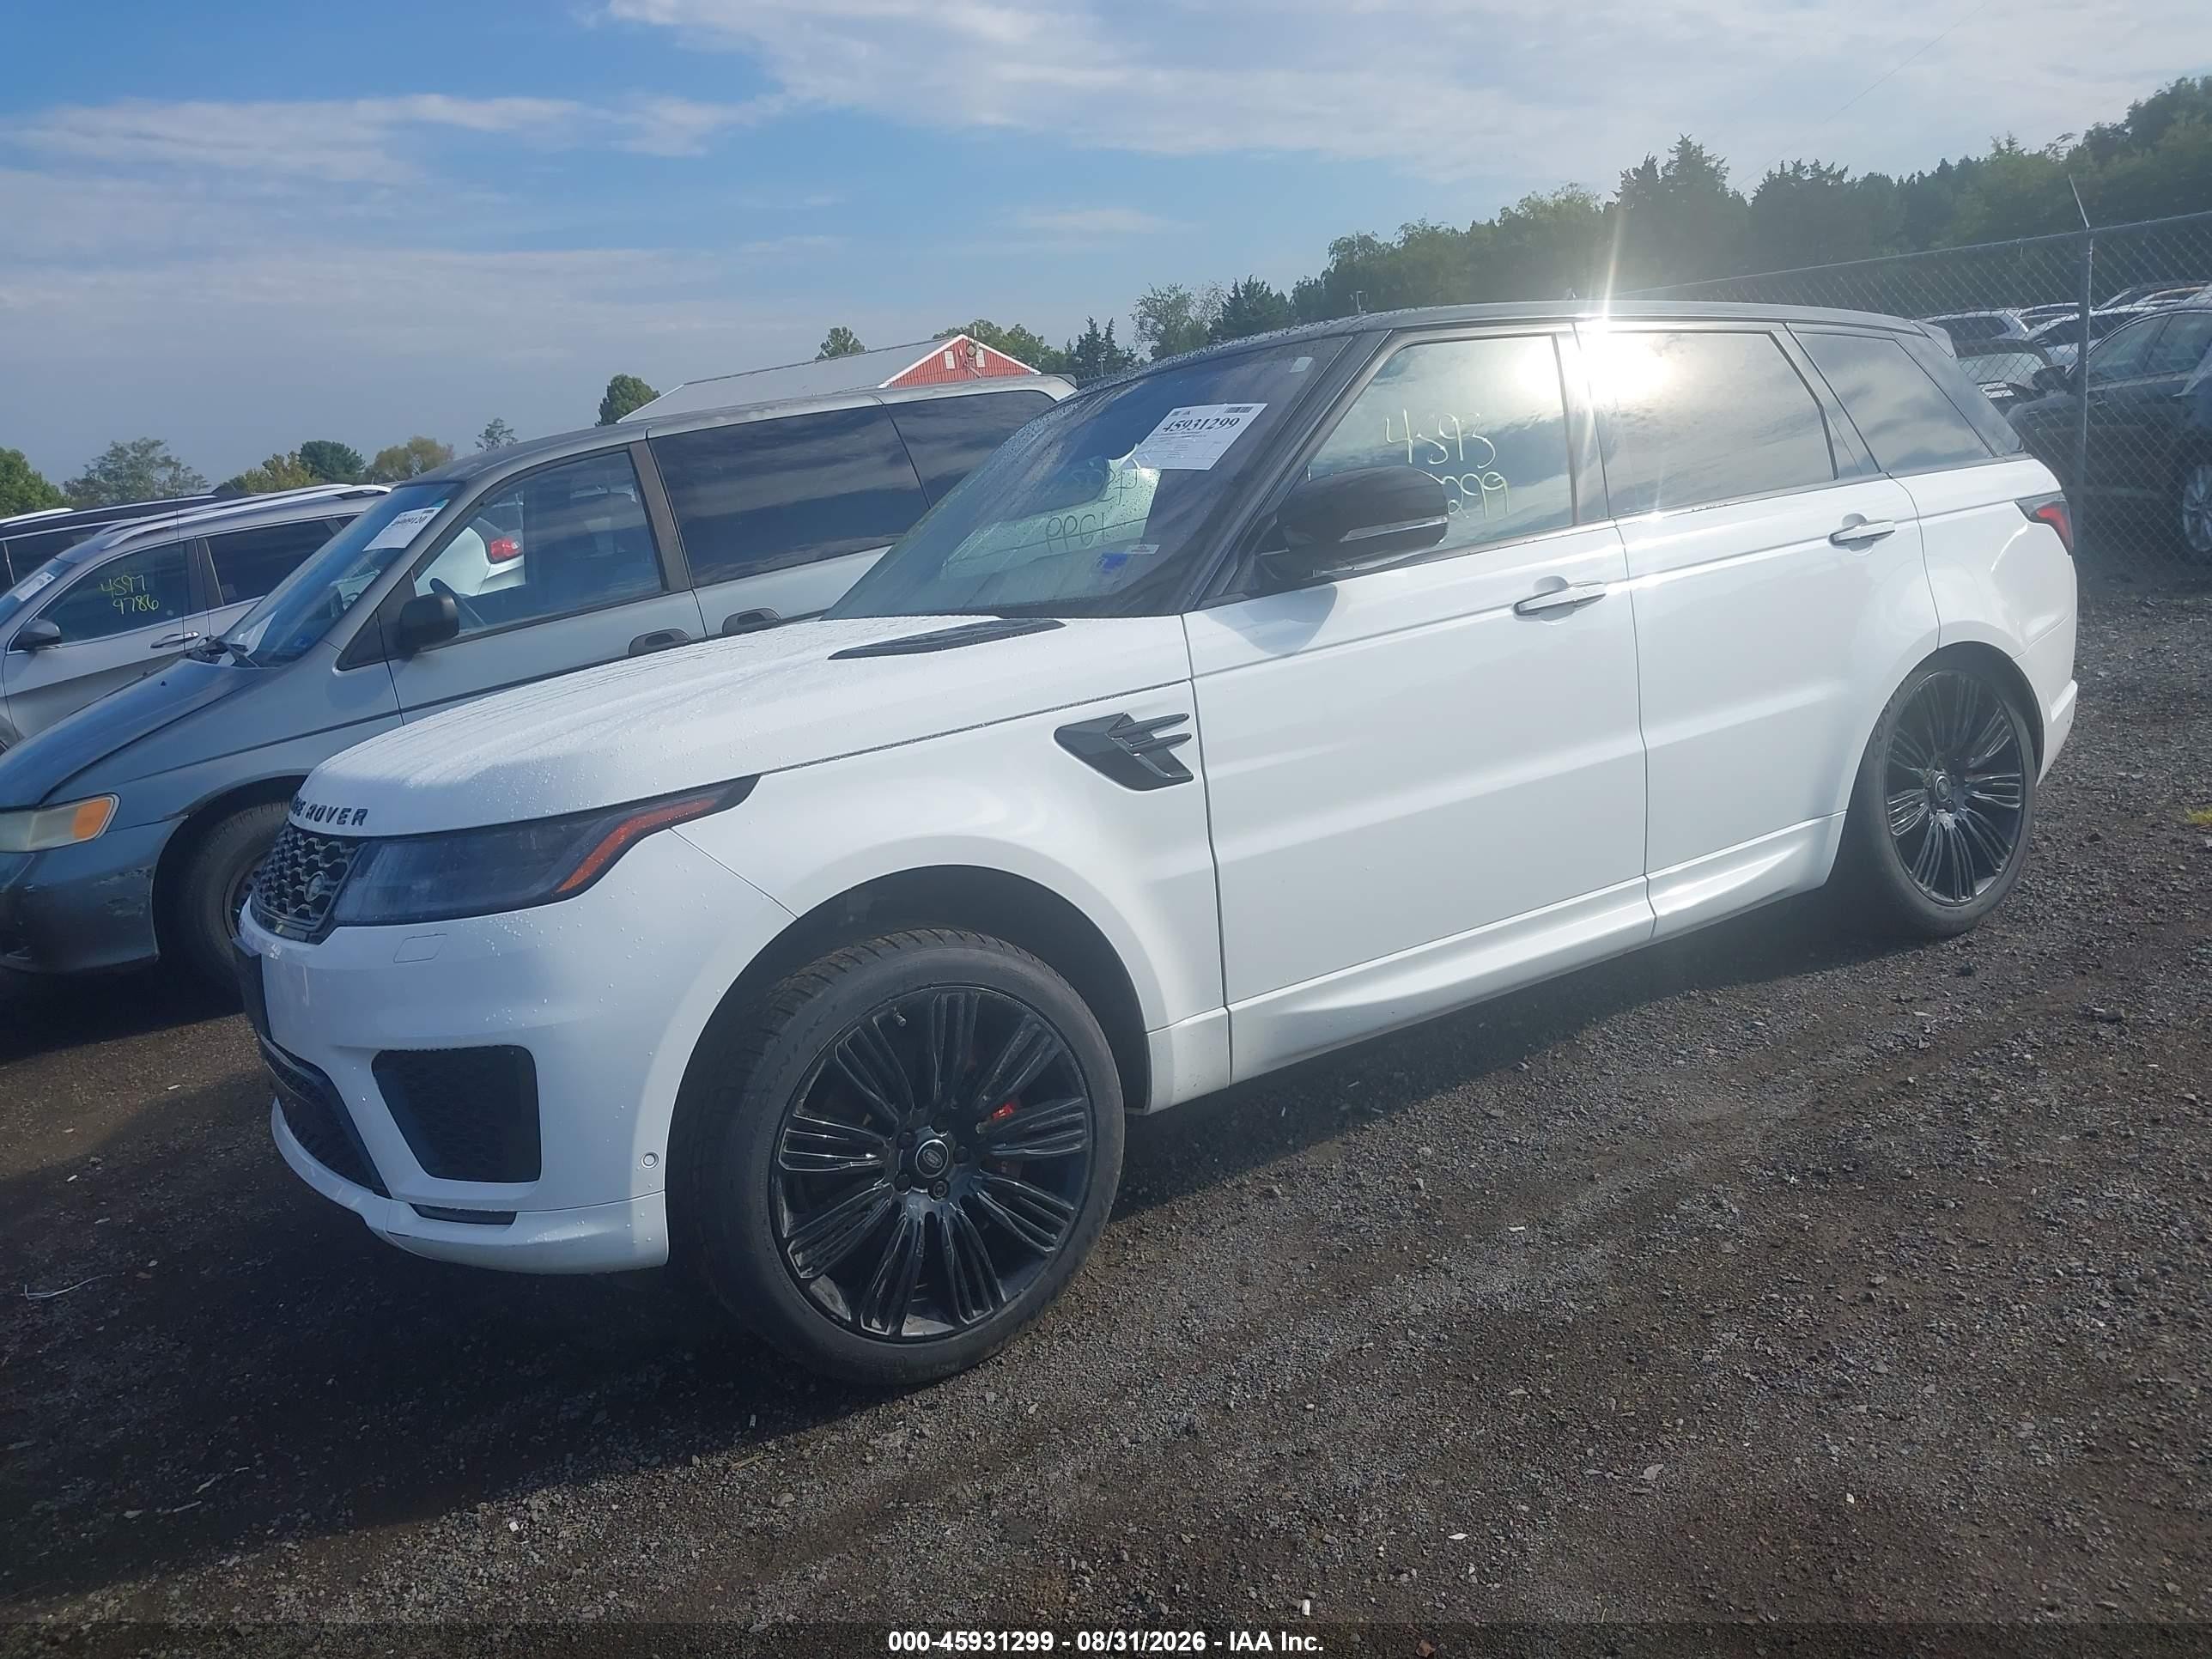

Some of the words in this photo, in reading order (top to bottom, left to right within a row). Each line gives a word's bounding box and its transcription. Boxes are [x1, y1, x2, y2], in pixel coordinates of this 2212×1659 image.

[1162, 417, 1241, 432] 45931299
[100, 574, 145, 598] 4597
[112, 594, 159, 615] 9786
[305, 804, 368, 826] ROVER
